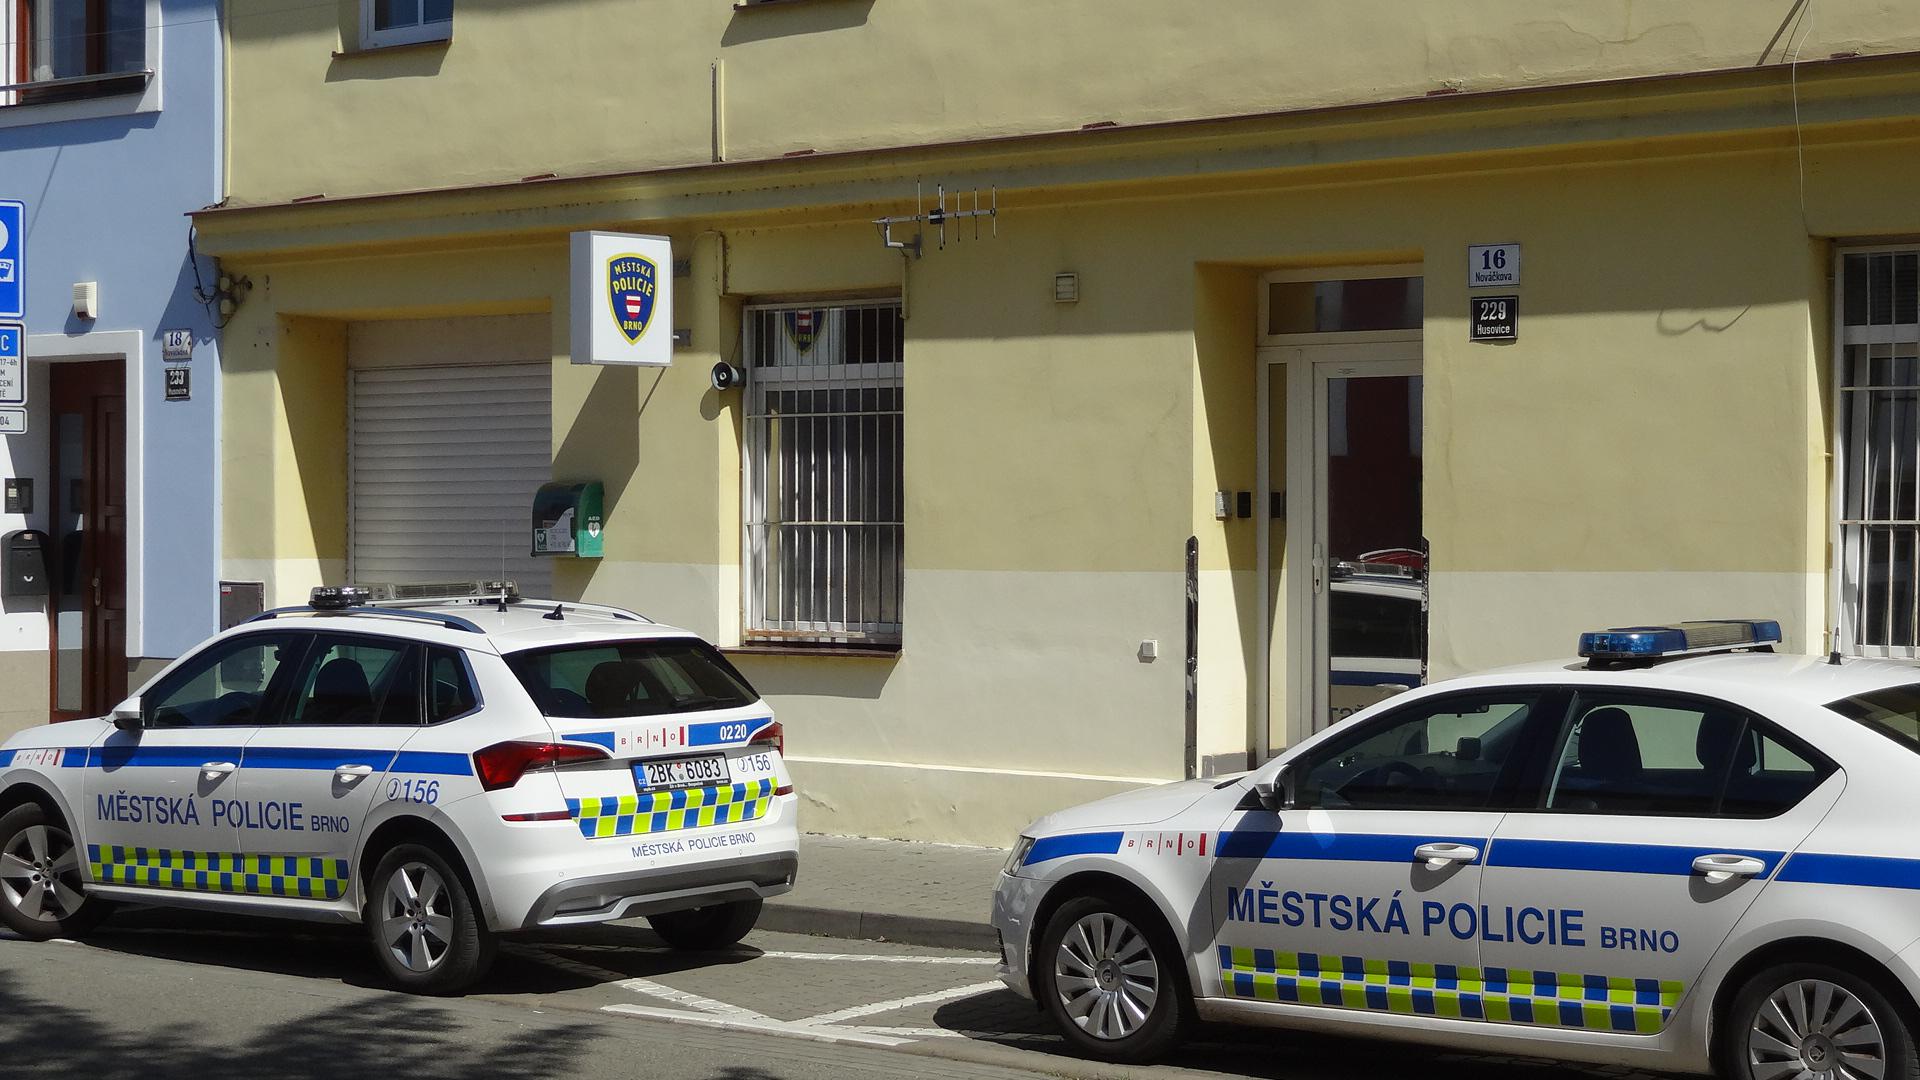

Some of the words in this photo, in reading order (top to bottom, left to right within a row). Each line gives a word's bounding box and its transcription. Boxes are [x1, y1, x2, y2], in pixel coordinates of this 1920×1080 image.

[1482, 249, 1506, 270] 16
[614, 261, 652, 278] MĚSTSKÁ
[1475, 271, 1512, 282] Nováčkova
[612, 276, 654, 297] POLICIE
[1480, 301, 1507, 320] 229
[623, 320, 643, 331] BRNO
[1477, 323, 1510, 335] Husovice
[169, 331, 182, 346] 18
[720, 724, 747, 740] 0220
[648, 763, 676, 784] 2BK
[685, 759, 721, 780] 6083
[748, 753, 771, 772] 156
[403, 779, 440, 805] 156
[97, 790, 200, 825] MĚSTSKÁ
[212, 799, 304, 831] POLICIE
[311, 815, 350, 833] BRNO
[631, 839, 685, 858] MĚSTSKÁ
[688, 836, 728, 851] POLICIE
[728, 832, 756, 846] BRNO
[1227, 880, 1410, 935] MĚSTSKÁ
[1423, 901, 1586, 947] POLICIE
[1600, 926, 1679, 953] BRNO
